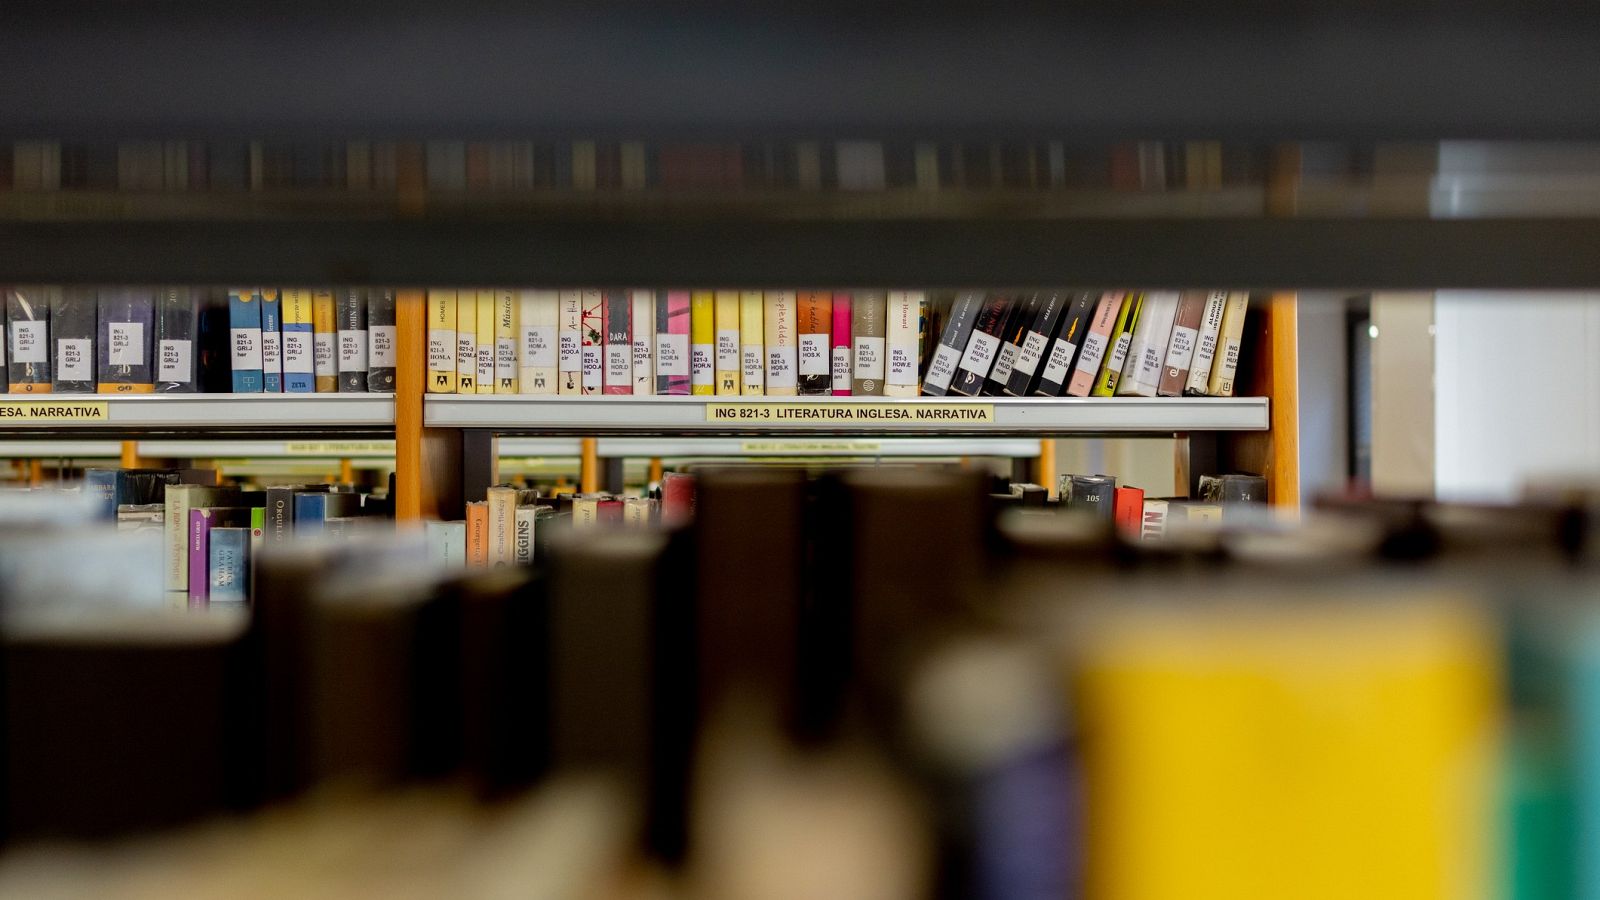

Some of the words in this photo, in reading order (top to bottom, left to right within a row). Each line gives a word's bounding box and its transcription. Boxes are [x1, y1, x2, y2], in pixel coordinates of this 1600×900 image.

[502, 296, 511, 328] Música
[609, 332, 628, 342] DARA
[1028, 335, 1040, 344] ING
[974, 343, 988, 353] 821-3
[1025, 342, 1039, 351] 821-3
[1085, 343, 1099, 352] 821-3
[1003, 348, 1013, 356] ING
[1052, 351, 1067, 361] 821-3
[935, 359, 949, 368] 821-3
[1000, 354, 1015, 364] 821-3
[0, 407, 26, 417] ESA.
[30, 407, 101, 417] NARRATIVA
[715, 408, 736, 418] ING
[739, 408, 770, 418] 821-3
[777, 408, 853, 419] LITERATURA
[856, 408, 913, 419] INGLESA.
[916, 409, 987, 420] NARRATIVA
[1086, 494, 1100, 502] 105
